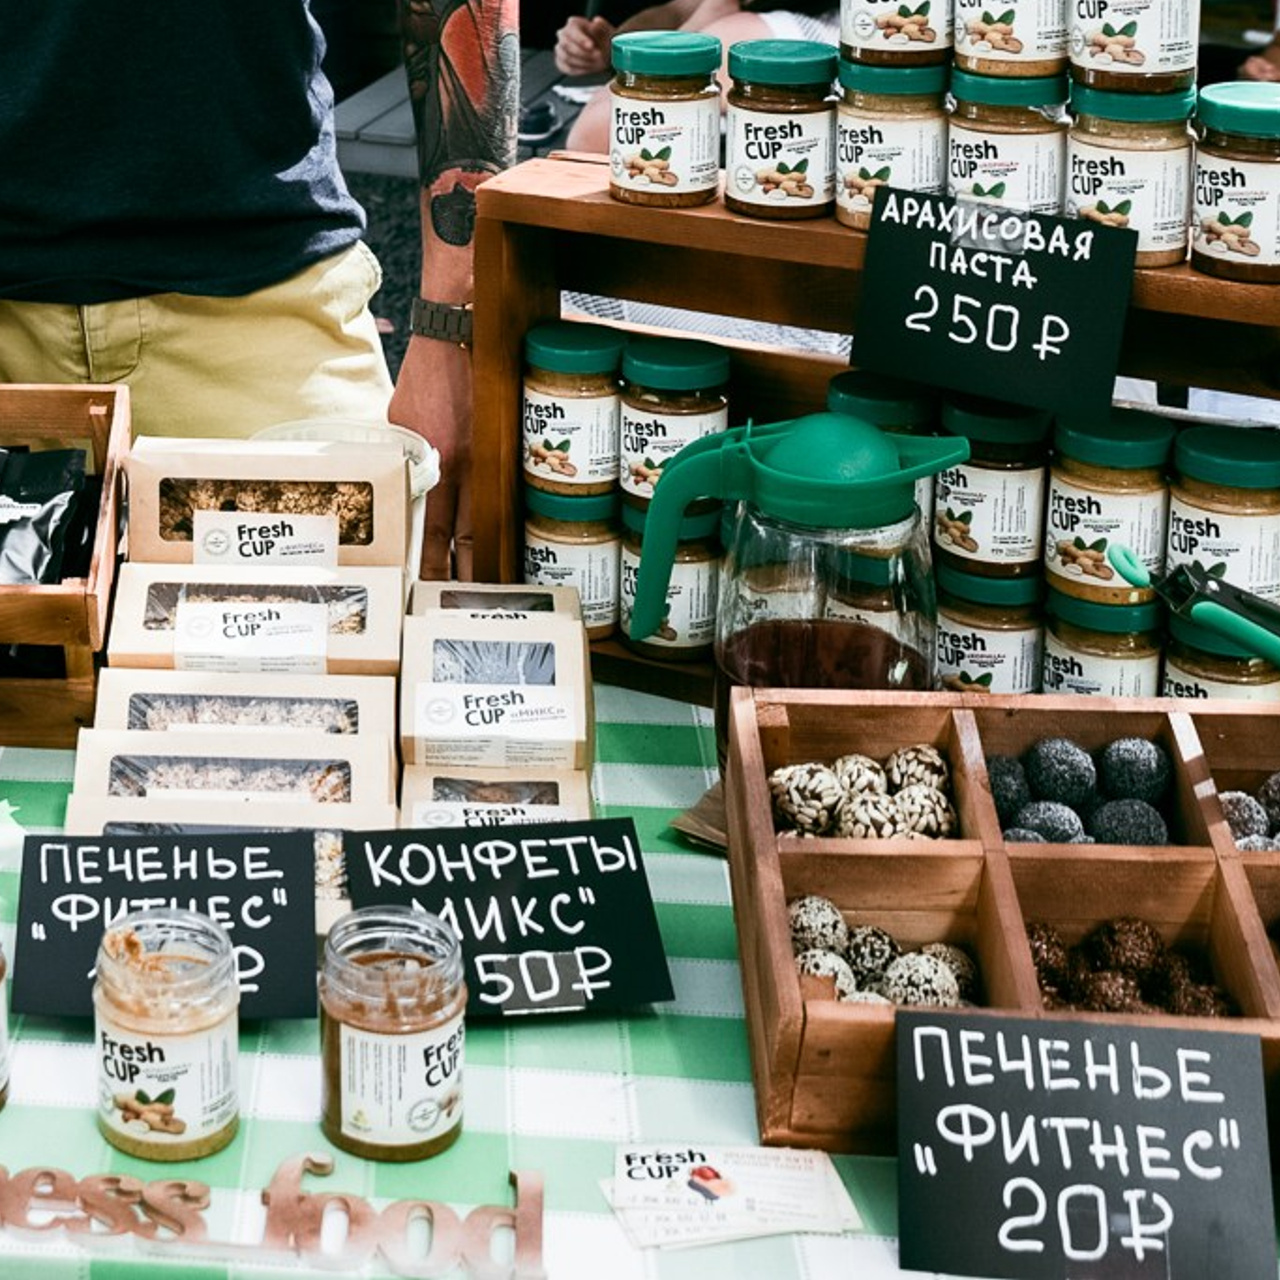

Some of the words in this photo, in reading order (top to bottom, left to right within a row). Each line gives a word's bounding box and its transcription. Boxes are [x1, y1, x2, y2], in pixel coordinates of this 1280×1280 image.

[1077, 0, 1108, 19] CUP
[615, 107, 664, 126] Fresh
[616, 127, 645, 144] CUP
[744, 120, 803, 141] Fresh
[838, 125, 883, 144] Fresh
[746, 141, 782, 159] CUP
[839, 144, 864, 163] CUP
[950, 138, 998, 159] Fresh
[951, 159, 978, 178] CUP
[1072, 154, 1125, 176] Fresh
[1072, 175, 1103, 195] CUP
[1196, 164, 1246, 187] Fresh
[1196, 185, 1223, 206] CUP
[880, 192, 1095, 261] АРАХИСОВАЯ
[929, 240, 1038, 289] ПАСТА
[524, 398, 565, 419] Fresh
[524, 417, 547, 434] CUP
[624, 416, 666, 437] Fresh
[624, 434, 648, 454] CUP
[1052, 489, 1101, 515] Fresh
[237, 521, 294, 541] Fresh
[1051, 510, 1080, 532] CUP
[1172, 511, 1220, 538] Fresh
[239, 540, 275, 557] CUP
[1172, 533, 1199, 555] CUP
[222, 609, 280, 624] Fresh
[223, 623, 261, 638] CUP
[464, 690, 525, 709] Fresh
[465, 708, 505, 726] CUP
[463, 807, 525, 817] Fresh
[40, 843, 284, 883] ПЕЧЕНЬЕ
[364, 835, 638, 887] КОНФЕТЫ
[101, 1030, 165, 1063] Fresh
[103, 1055, 140, 1083] CUP
[913, 1025, 1225, 1103] ПЕЧЕНЬЕ
[624, 1149, 707, 1167] Fresh
[627, 1165, 680, 1181] CUP
[263, 1151, 547, 1279] food
